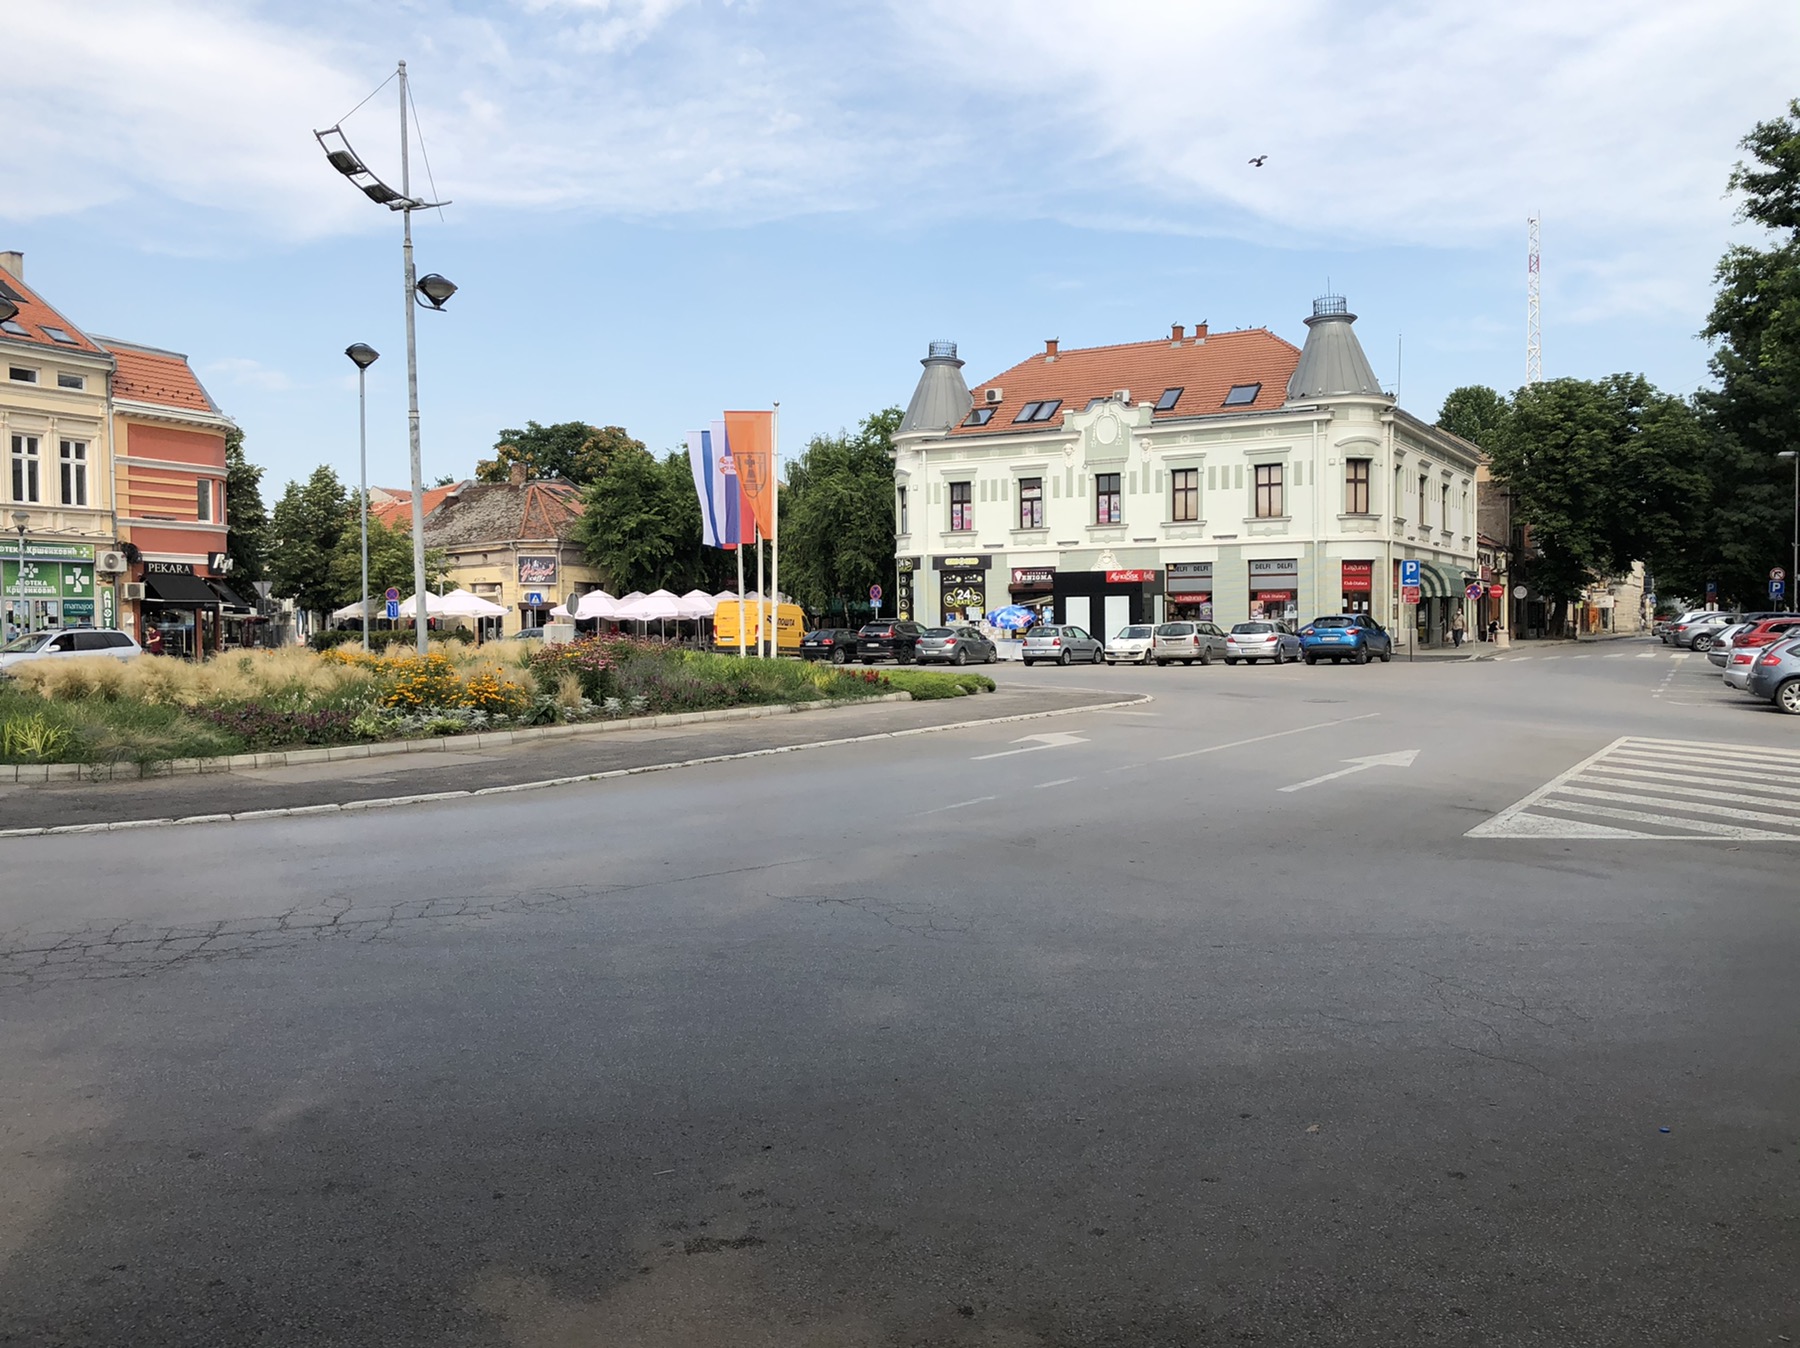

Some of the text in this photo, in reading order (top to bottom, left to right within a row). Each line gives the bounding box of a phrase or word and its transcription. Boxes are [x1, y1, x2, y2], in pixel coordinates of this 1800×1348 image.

[148, 563, 190, 573] PEKARA
[1406, 562, 1416, 575] P
[1706, 583, 1714, 592] P
[1772, 582, 1781, 592] P
[957, 589, 971, 600] 24
[64, 603, 93, 611] mamajoo
[103, 590, 112, 630] АПОТ
